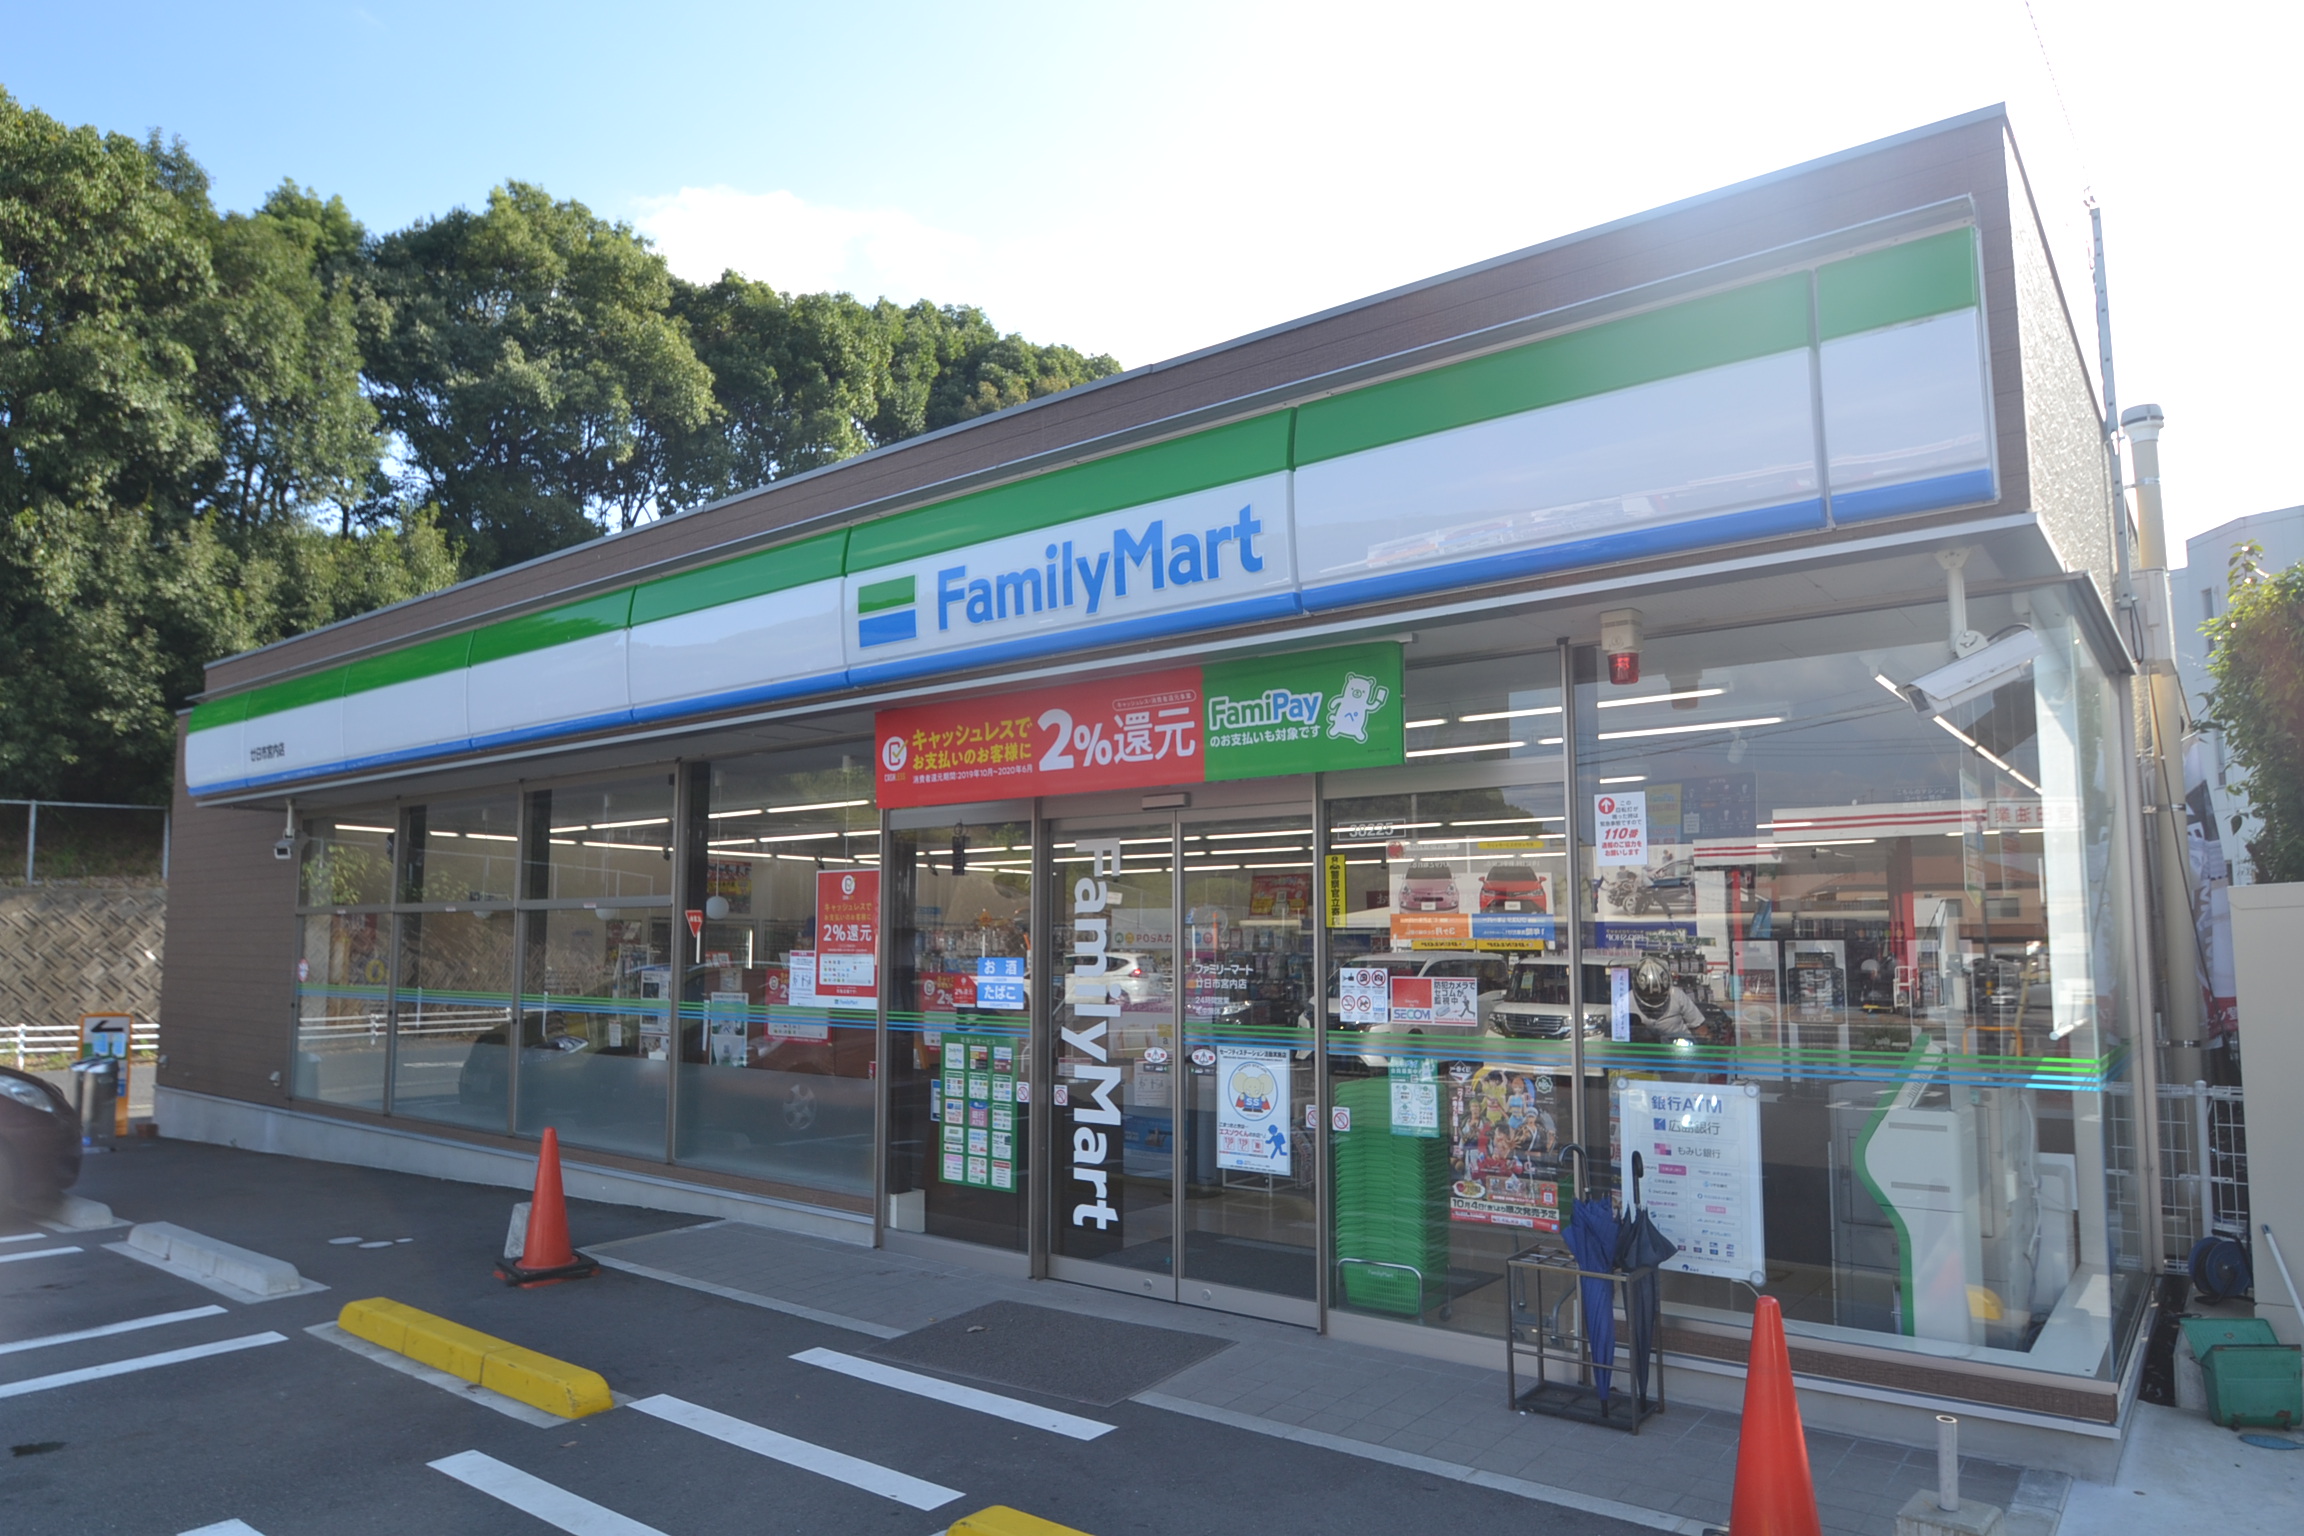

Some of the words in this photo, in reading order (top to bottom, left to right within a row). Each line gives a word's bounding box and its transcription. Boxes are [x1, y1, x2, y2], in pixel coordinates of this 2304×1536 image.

[938, 504, 1263, 631] FamilyMart
[1209, 689, 1322, 730] FamiPay
[912, 717, 1033, 751] キャッシュレスで
[1037, 707, 1196, 772] 2%還元
[1210, 725, 1321, 748] のお支払いも対象です
[913, 742, 1032, 771] お支払いのお客様に
[1605, 828, 1639, 840] 110番
[1601, 841, 1642, 849] 通報のご協力を
[1605, 849, 1640, 857] お願いします
[824, 902, 873, 913] キャッシュレスで
[823, 924, 872, 941] 2%還元
[1194, 964, 1254, 975] ファミリーマート
[1195, 977, 1248, 990] 廿日市宮内店
[1434, 981, 1475, 990] 防犯カメラで
[984, 984, 1016, 1000] たばこ
[1434, 989, 1464, 998] セコムが
[1434, 997, 1459, 1005] 監視中
[1394, 1009, 1430, 1020] SECOM
[1061, 838, 1121, 1230] FamilyMart
[1246, 1097, 1260, 1106] SS
[1652, 1095, 1722, 1114] 銀行ATM
[1678, 1146, 1720, 1159] もみじ銀行
[1452, 1199, 1557, 1219] 10月4日(金)より順次発売予定
